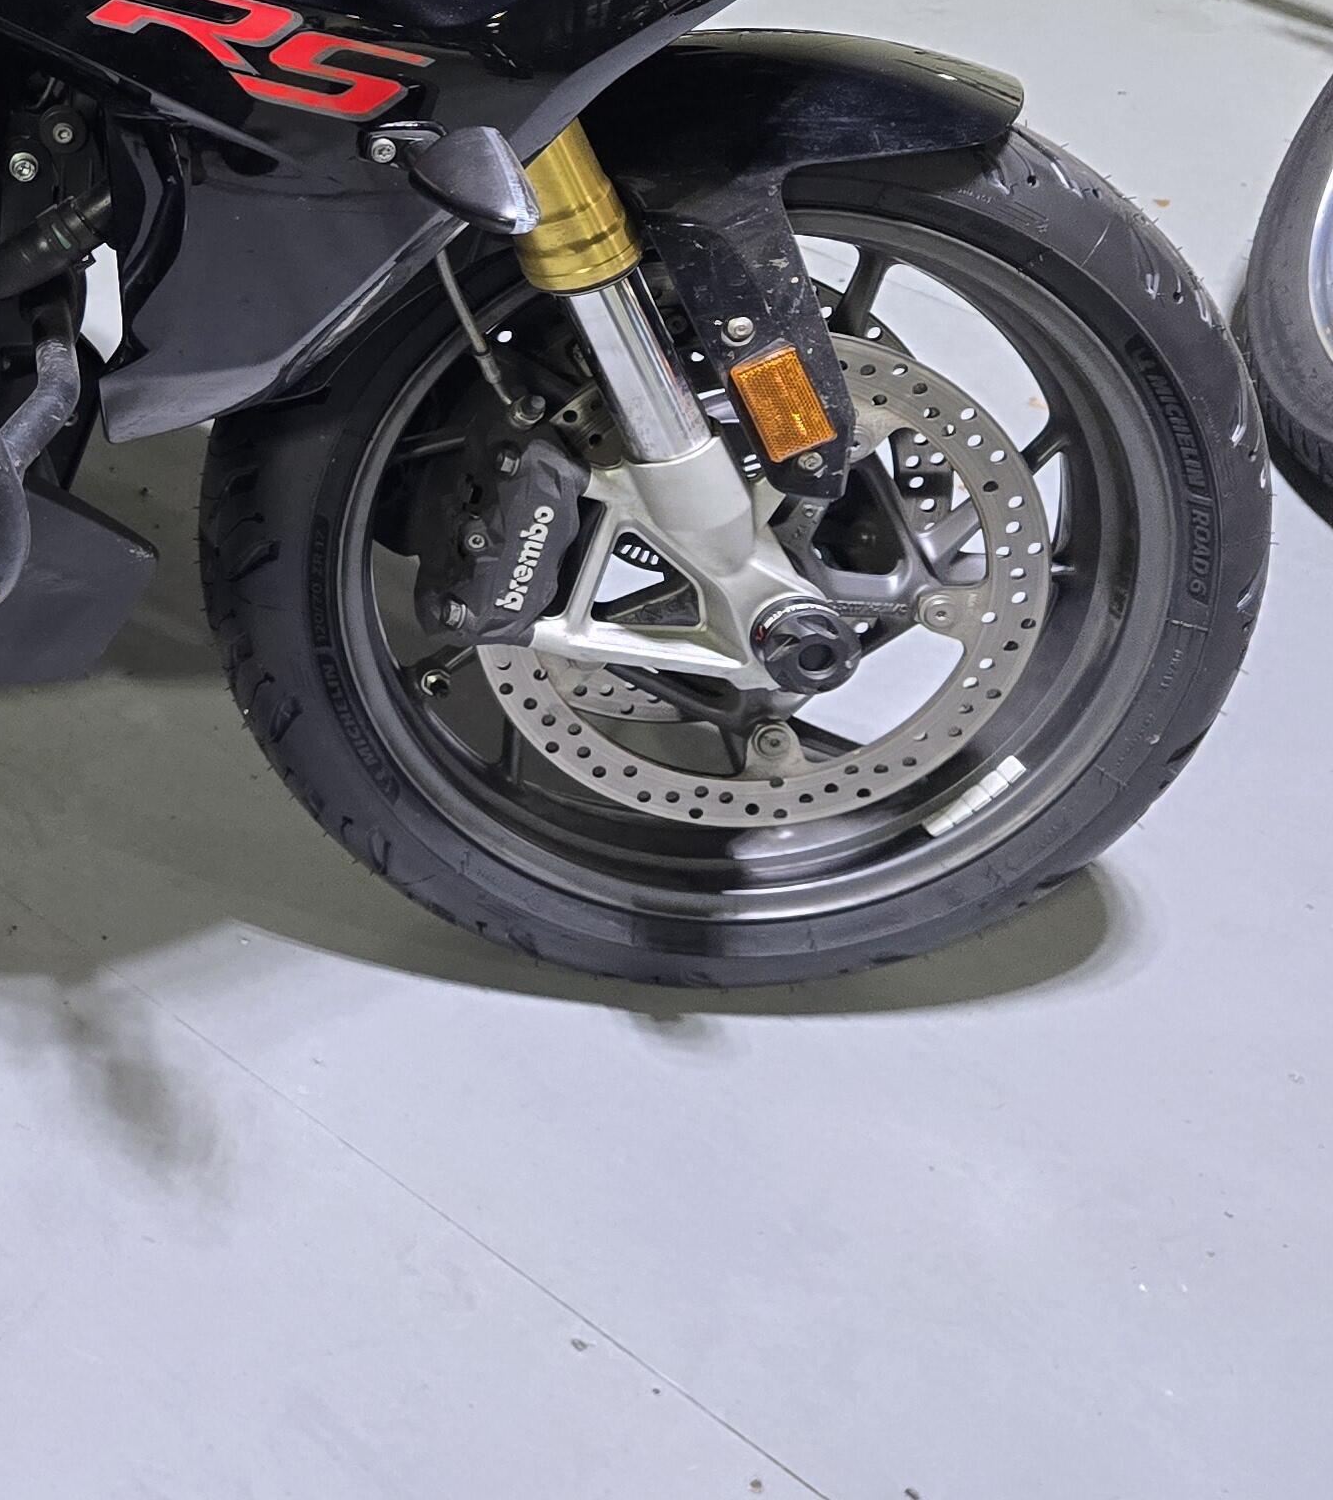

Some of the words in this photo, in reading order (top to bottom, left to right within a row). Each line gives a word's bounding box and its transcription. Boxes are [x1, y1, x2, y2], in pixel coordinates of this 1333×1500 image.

[1145, 372, 1207, 490] MICHELIN
[1191, 508, 1213, 575] ROAD
[494, 505, 555, 612] brembo
[322, 662, 379, 770] MICHELIN
